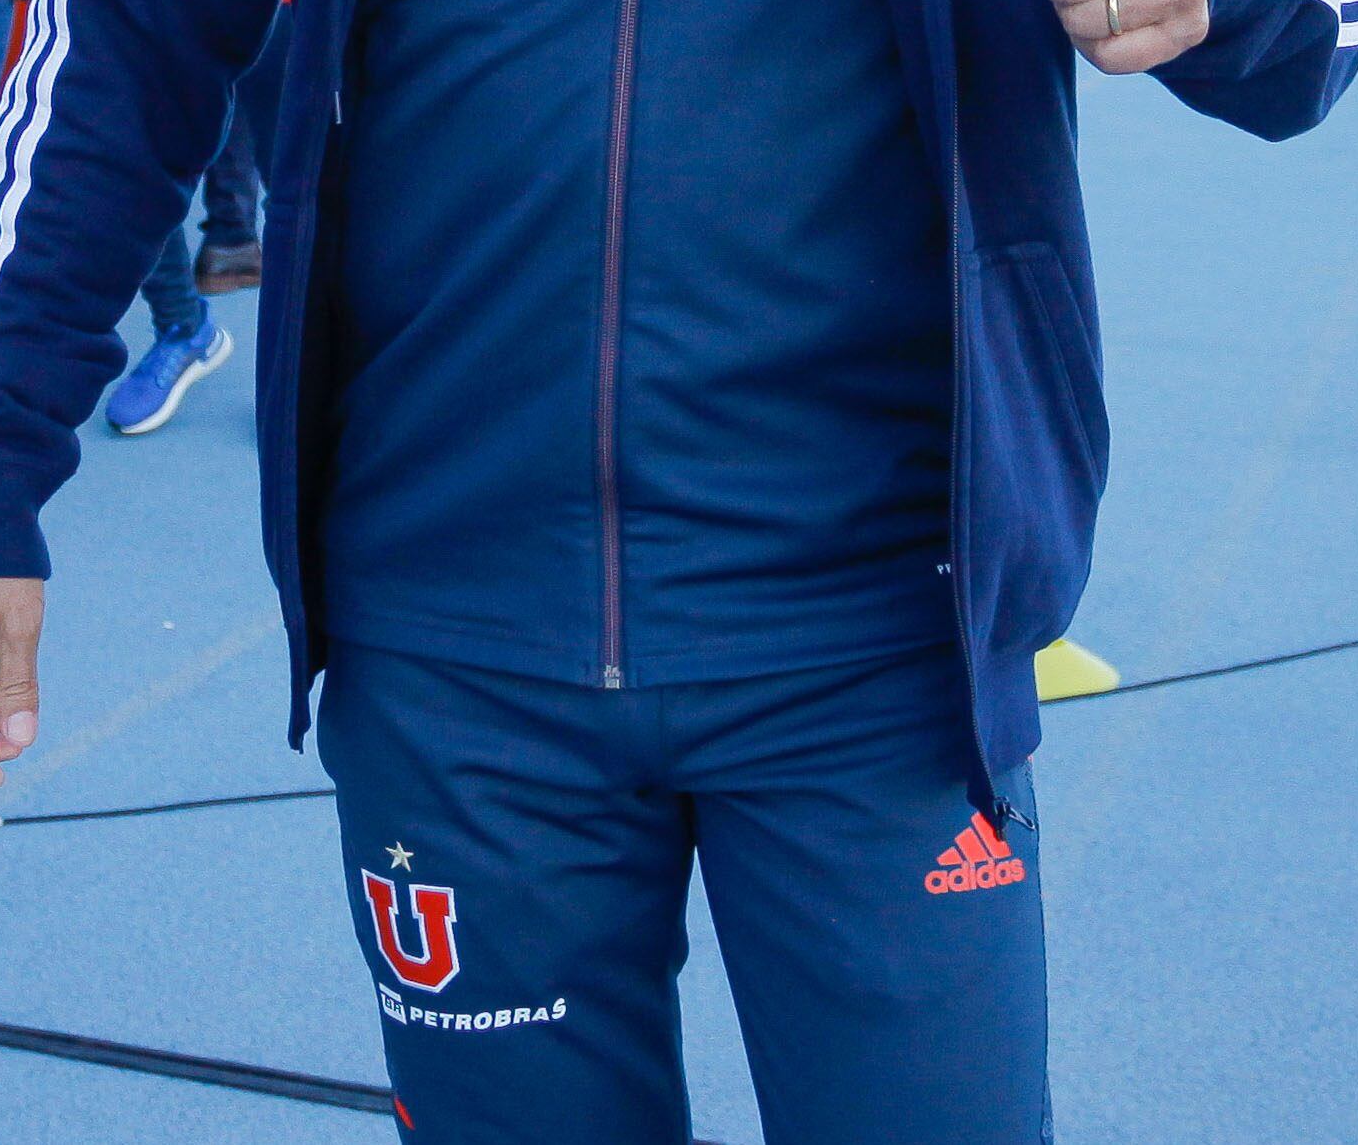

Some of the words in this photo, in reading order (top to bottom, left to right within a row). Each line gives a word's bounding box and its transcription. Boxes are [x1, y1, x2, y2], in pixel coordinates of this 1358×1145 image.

[924, 857, 1026, 895] adidas
[360, 867, 461, 994] U
[409, 997, 568, 1031] PETROBRAS
